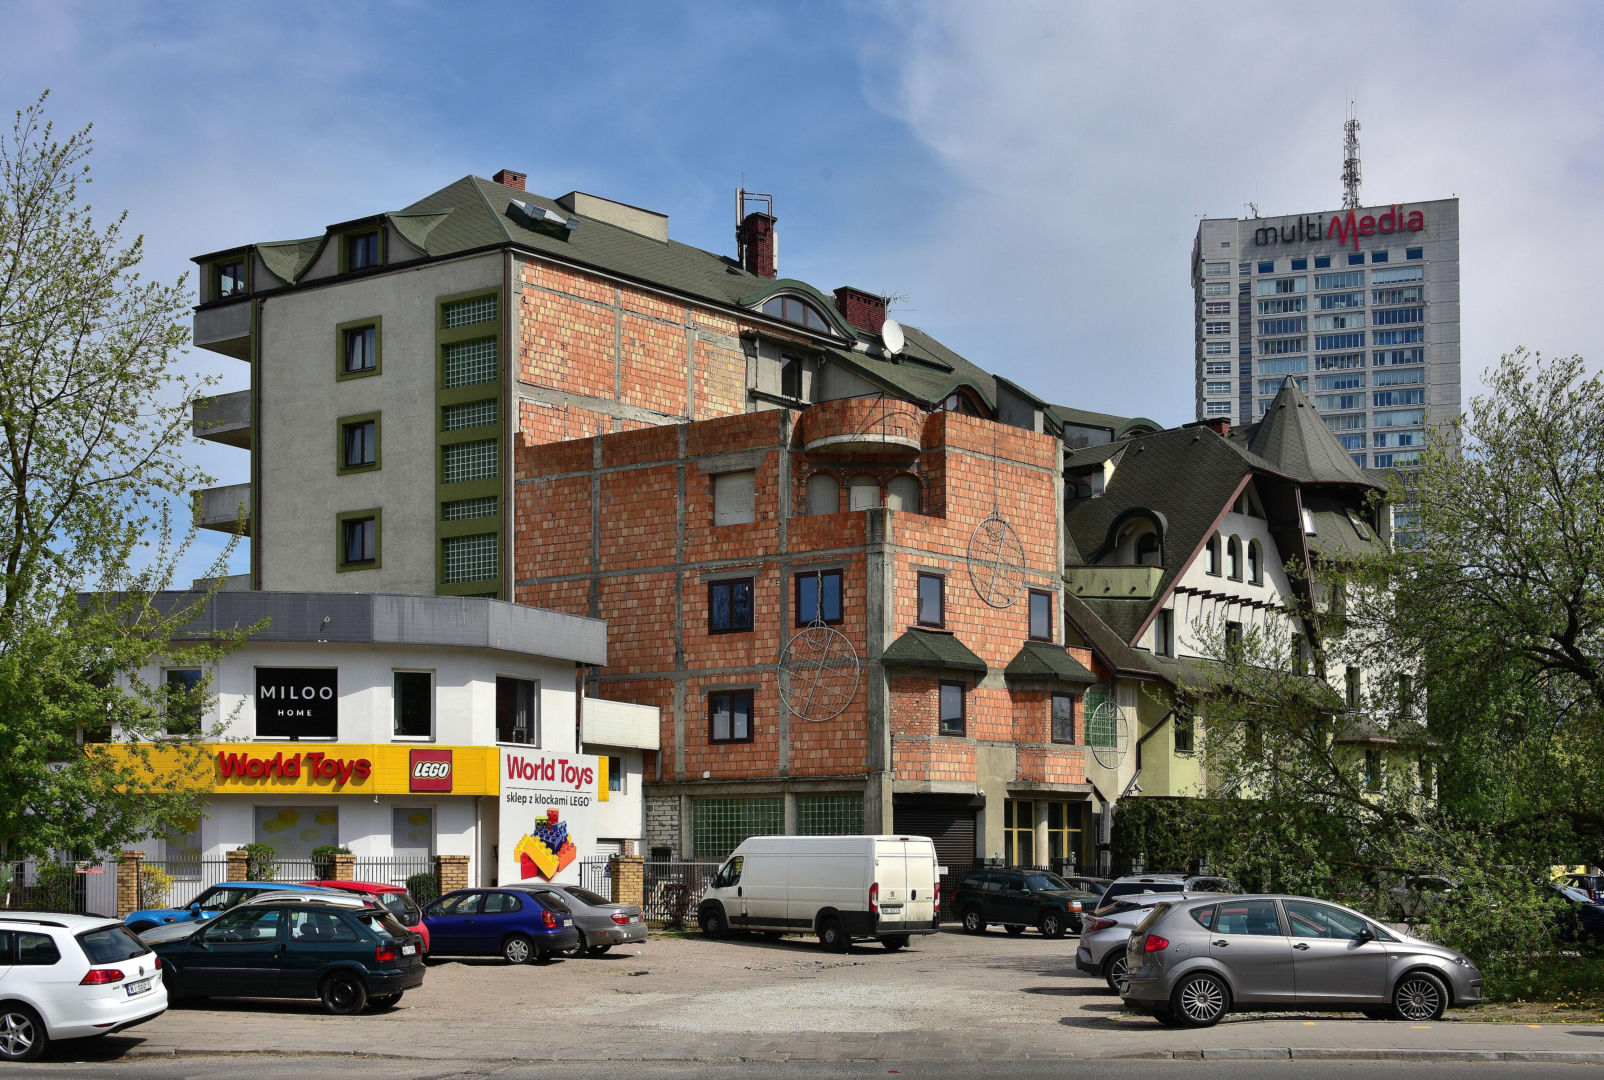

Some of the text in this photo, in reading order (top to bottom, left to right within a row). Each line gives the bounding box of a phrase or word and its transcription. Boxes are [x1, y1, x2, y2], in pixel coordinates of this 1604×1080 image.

[260, 685, 333, 700] MILOO
[277, 709, 312, 717] HOME
[218, 751, 372, 784] World Toys
[413, 761, 450, 778] LEGO
[506, 753, 593, 790] World Toys
[506, 792, 527, 805] sklep
[528, 796, 533, 804] z
[534, 793, 568, 806] klockami
